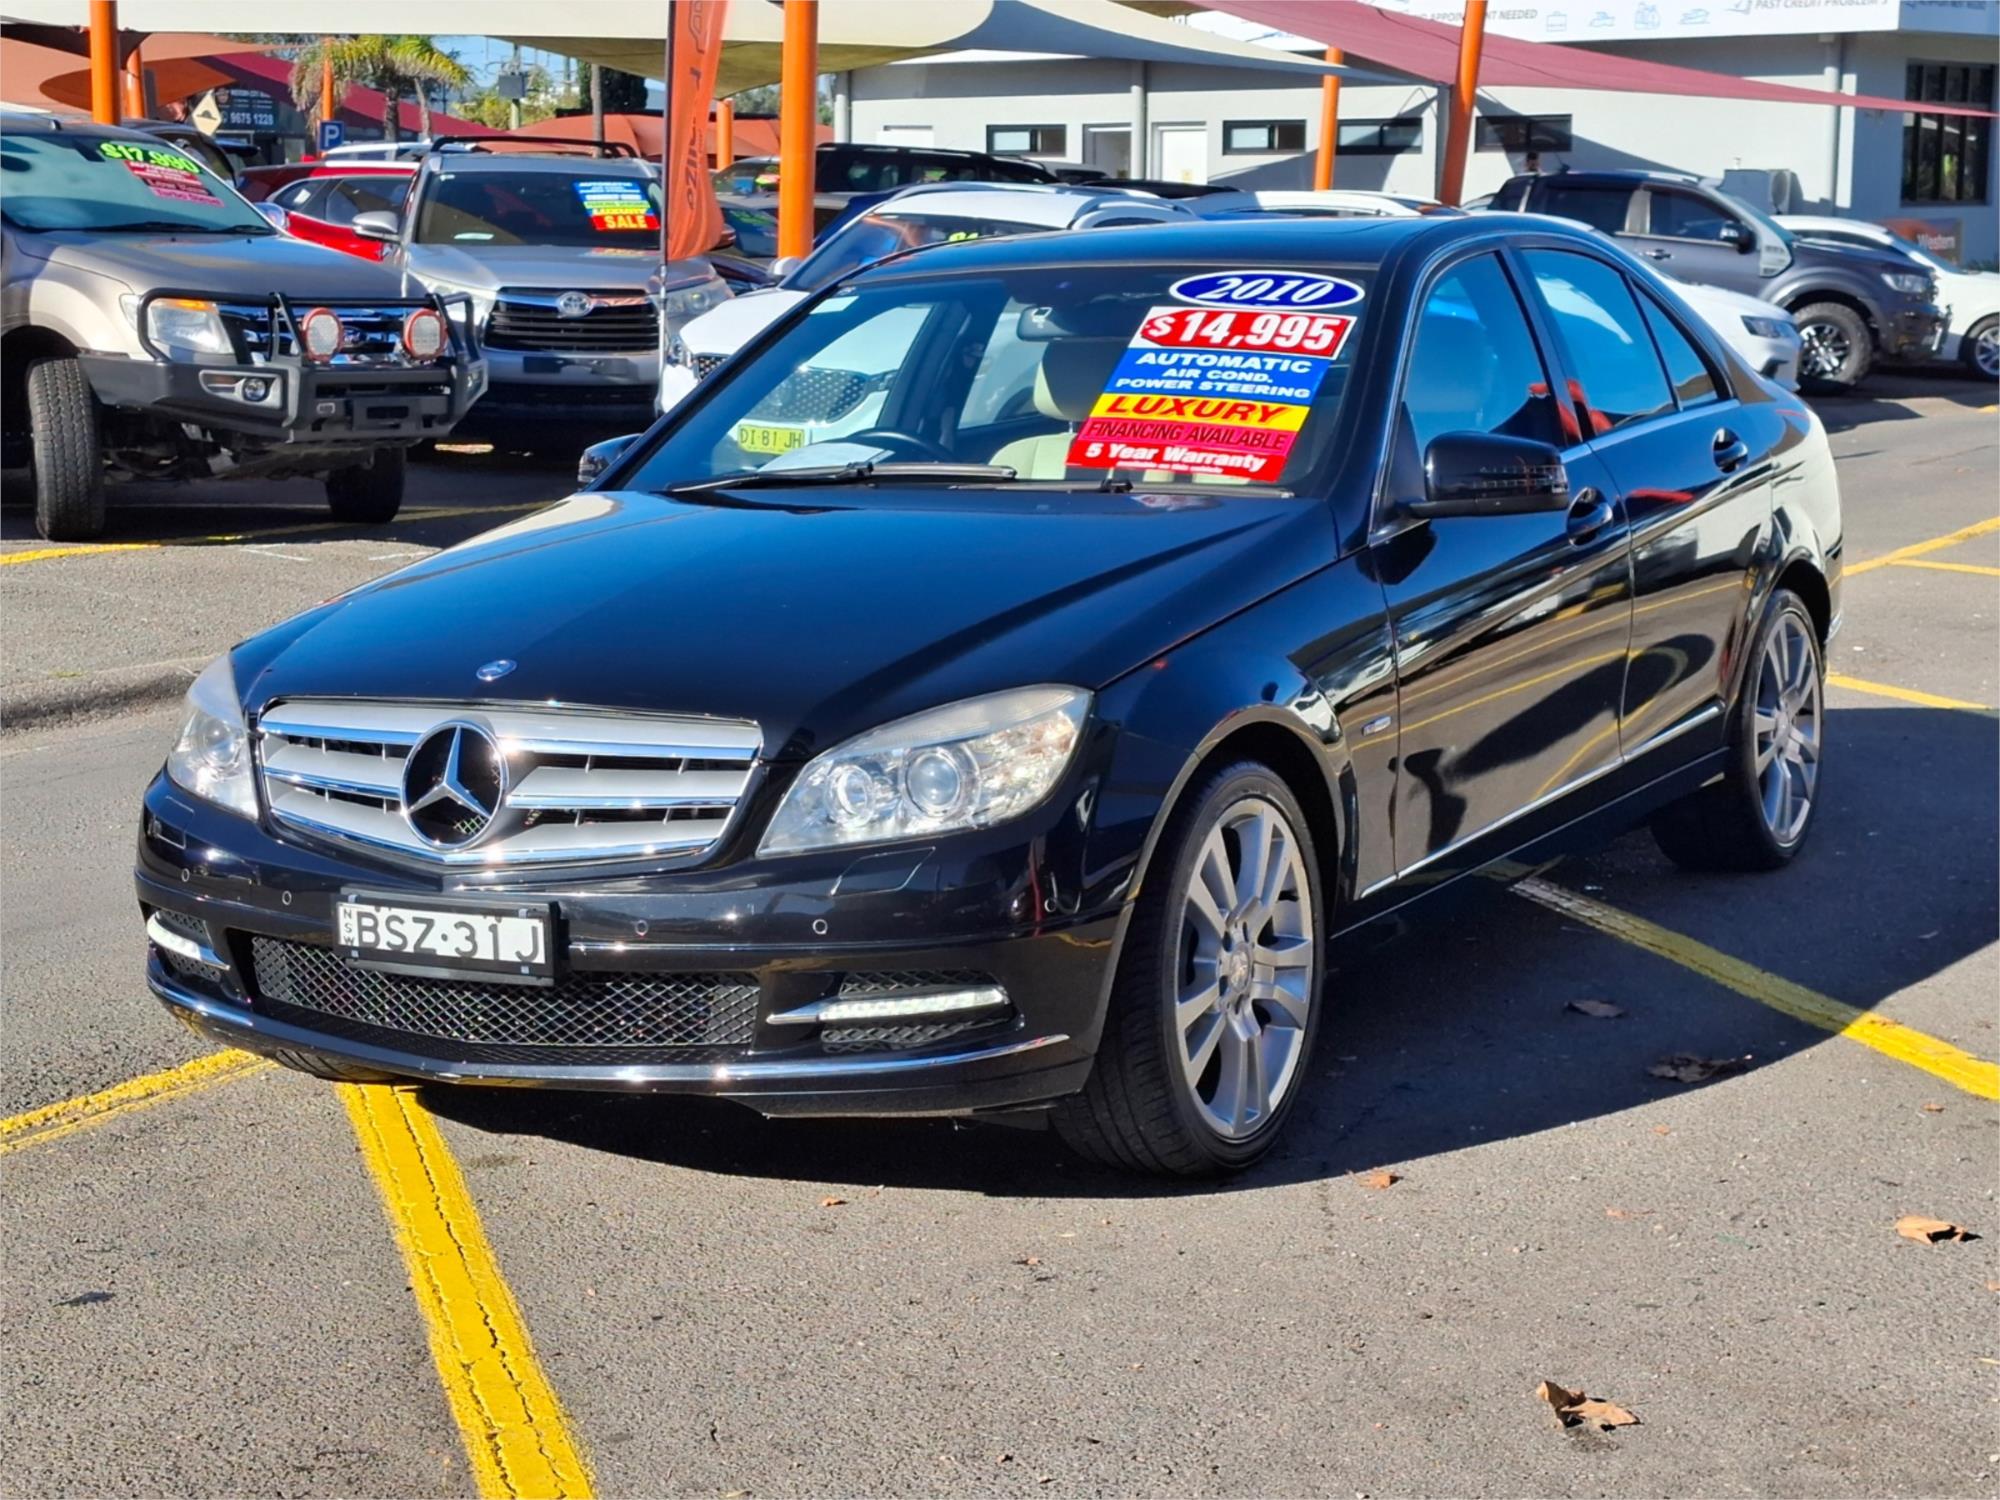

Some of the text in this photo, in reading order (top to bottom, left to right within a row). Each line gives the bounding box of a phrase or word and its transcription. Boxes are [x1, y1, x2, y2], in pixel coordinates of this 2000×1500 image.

[1499, 9, 1538, 20] NEEDED
[324, 124, 340, 148] P
[603, 214, 648, 230] SALE
[1195, 277, 1335, 303] 2010
[1147, 311, 1342, 351] $14,995
[1135, 352, 1312, 374] AUTOMATIC
[1162, 367, 1273, 384] AIR COND.
[1115, 377, 1311, 399] POWER STEERING
[1106, 395, 1291, 423] LUXURY
[1086, 420, 1290, 450] FINANCING AVAILABLE
[1085, 442, 1267, 472] 5 Year Warranty
